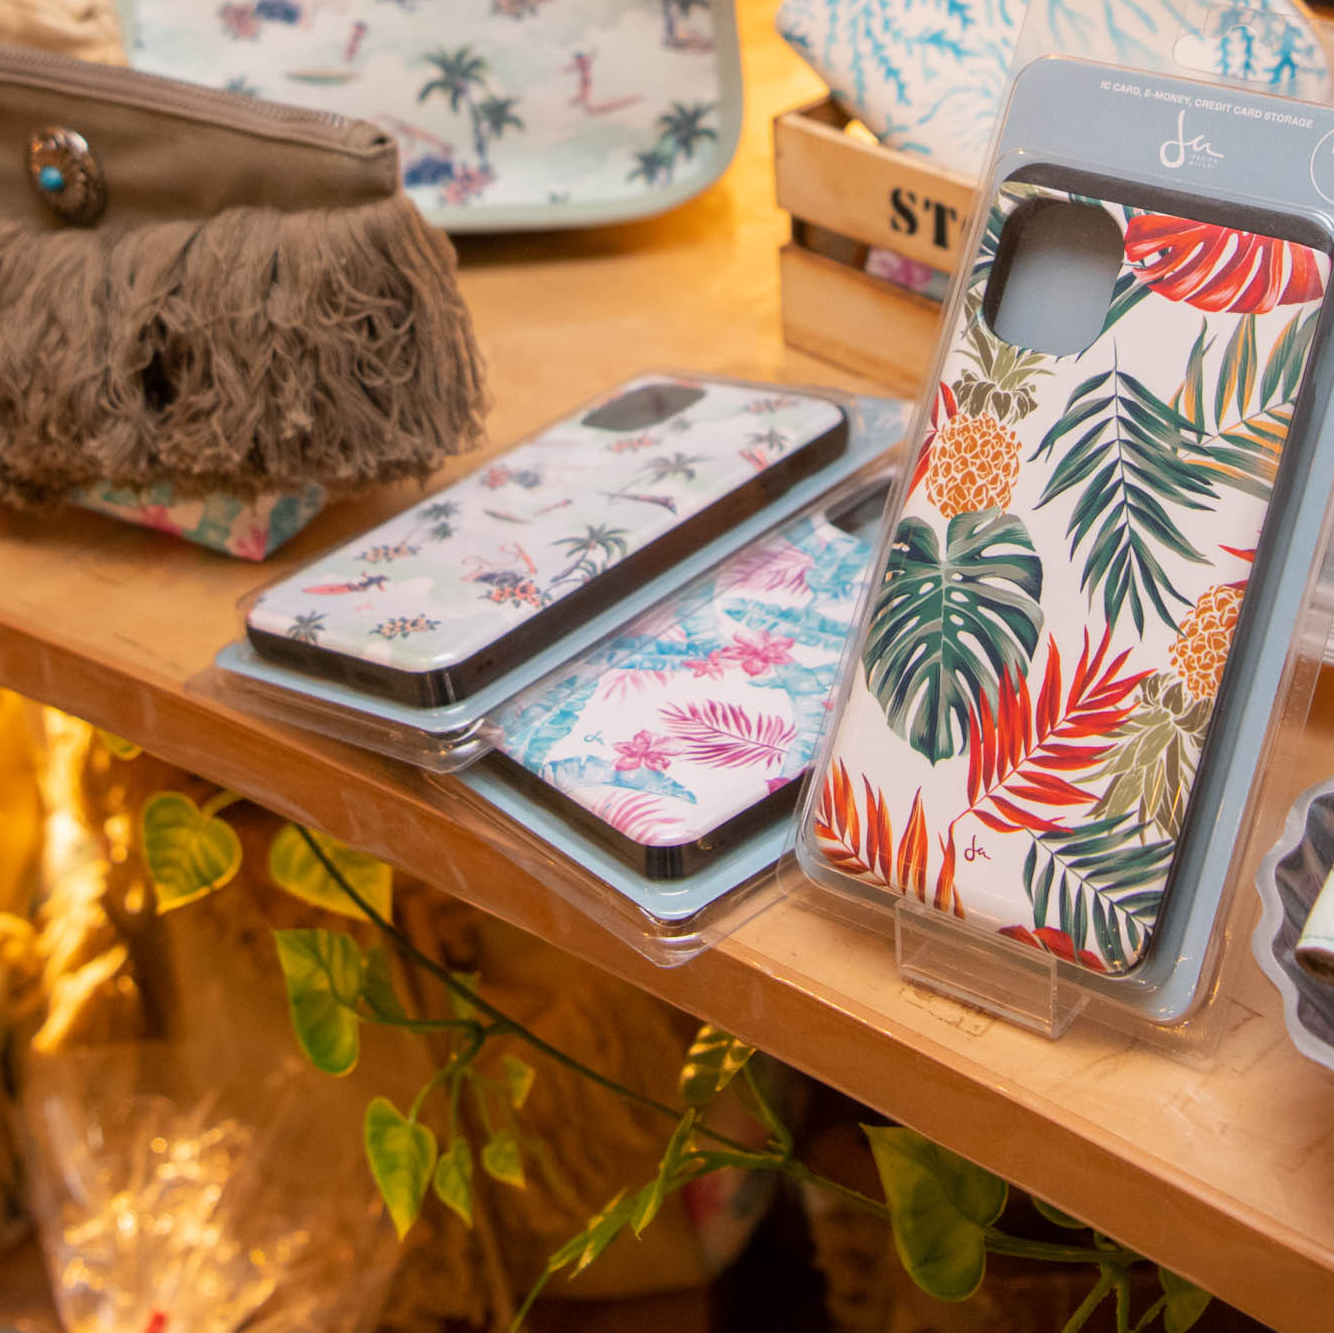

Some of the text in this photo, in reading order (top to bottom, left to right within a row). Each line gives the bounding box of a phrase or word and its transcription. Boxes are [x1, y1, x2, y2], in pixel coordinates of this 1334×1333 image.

[1195, 98, 1233, 114] CREDIT
[1233, 105, 1263, 120] CARD
[1264, 110, 1316, 130] STORAGE
[890, 187, 967, 250] ST
